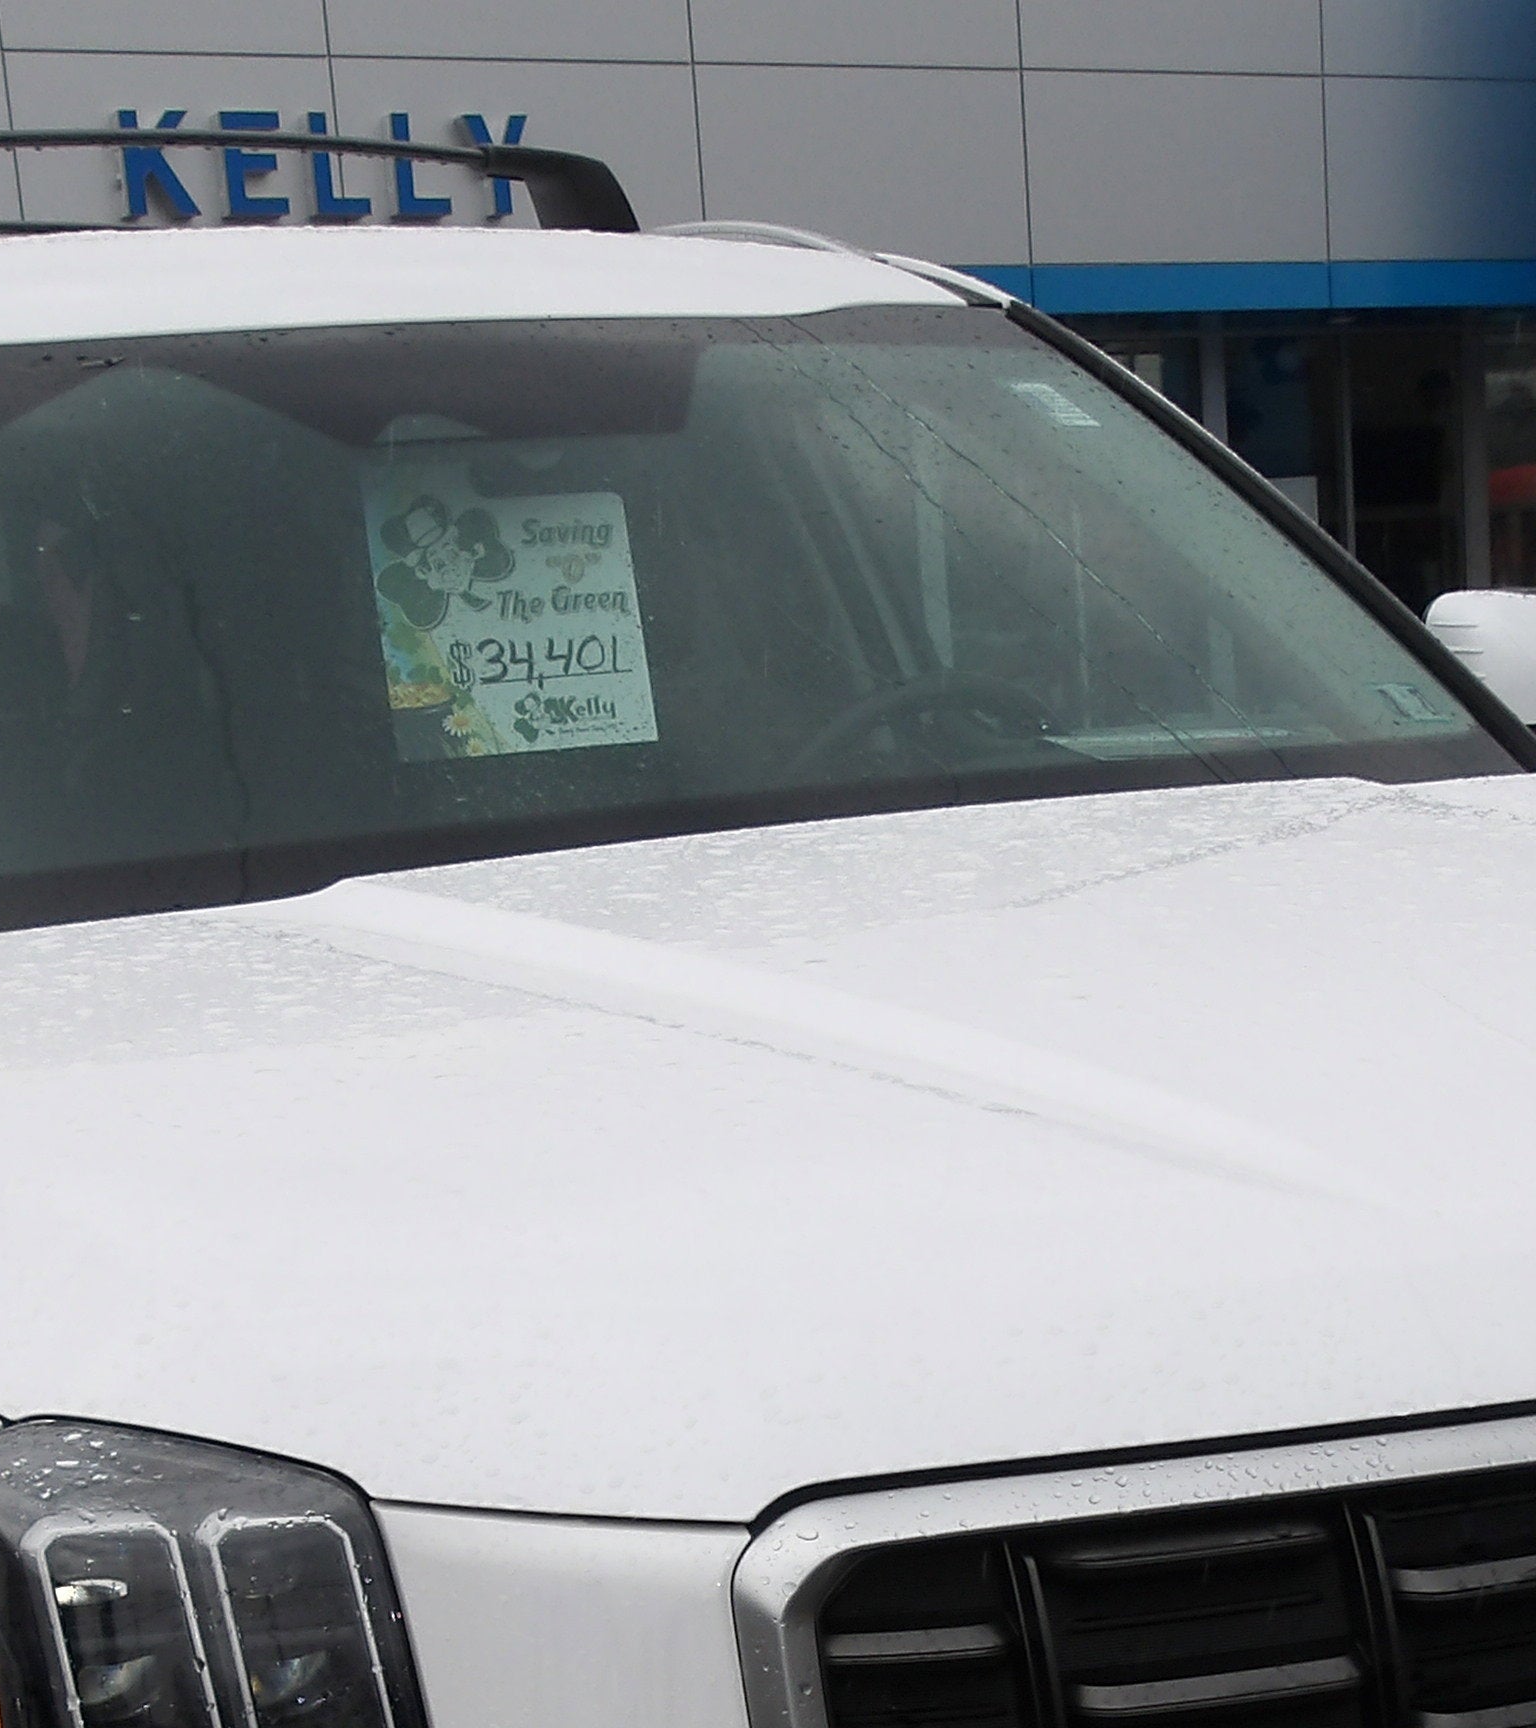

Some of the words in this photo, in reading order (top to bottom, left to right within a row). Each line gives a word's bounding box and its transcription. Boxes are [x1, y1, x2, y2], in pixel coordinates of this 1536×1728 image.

[117, 109, 528, 218] KELLY
[520, 518, 613, 547] Saving
[496, 589, 546, 622] The
[551, 586, 631, 616] Green
[556, 695, 617, 723] Kelly
